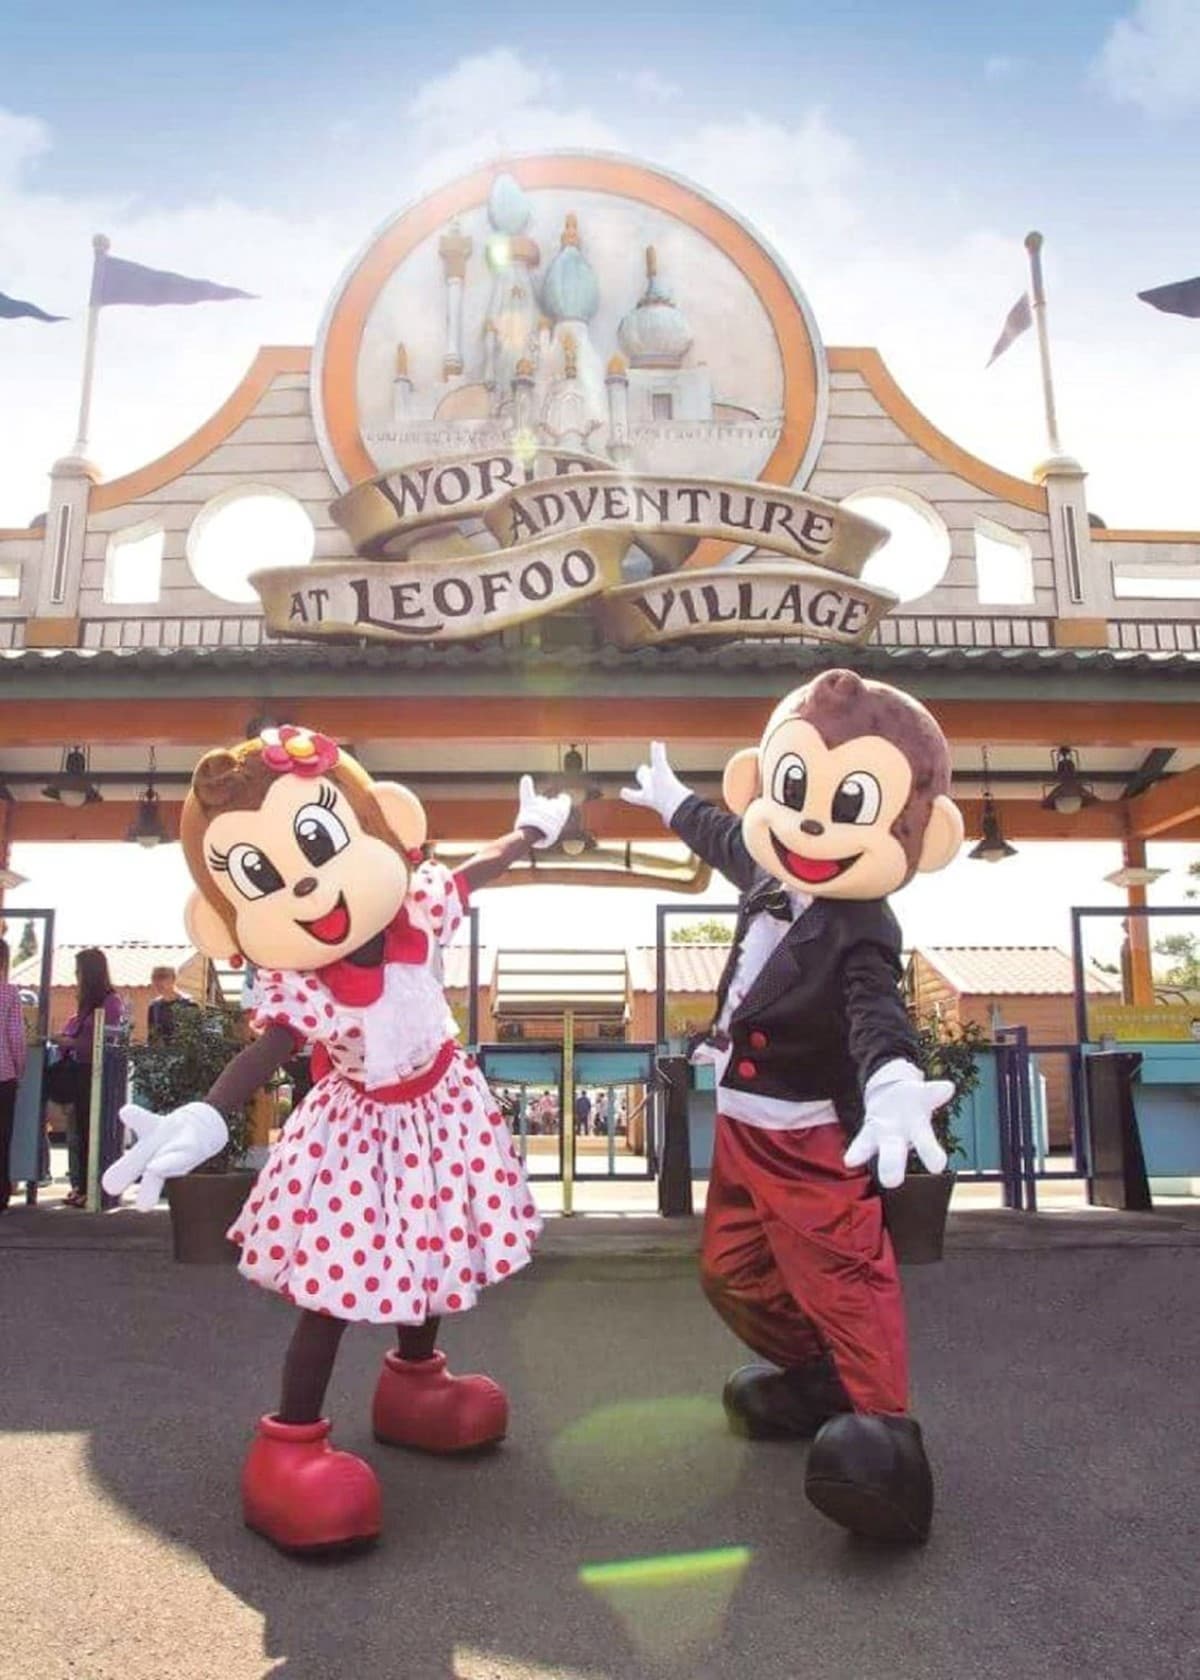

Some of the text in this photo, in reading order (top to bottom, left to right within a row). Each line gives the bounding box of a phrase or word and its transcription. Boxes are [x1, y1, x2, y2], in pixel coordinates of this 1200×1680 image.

[511, 486, 834, 554] ADVENTURE
[289, 550, 596, 634] AT LEOFOO
[632, 582, 869, 634] VILLAGE
